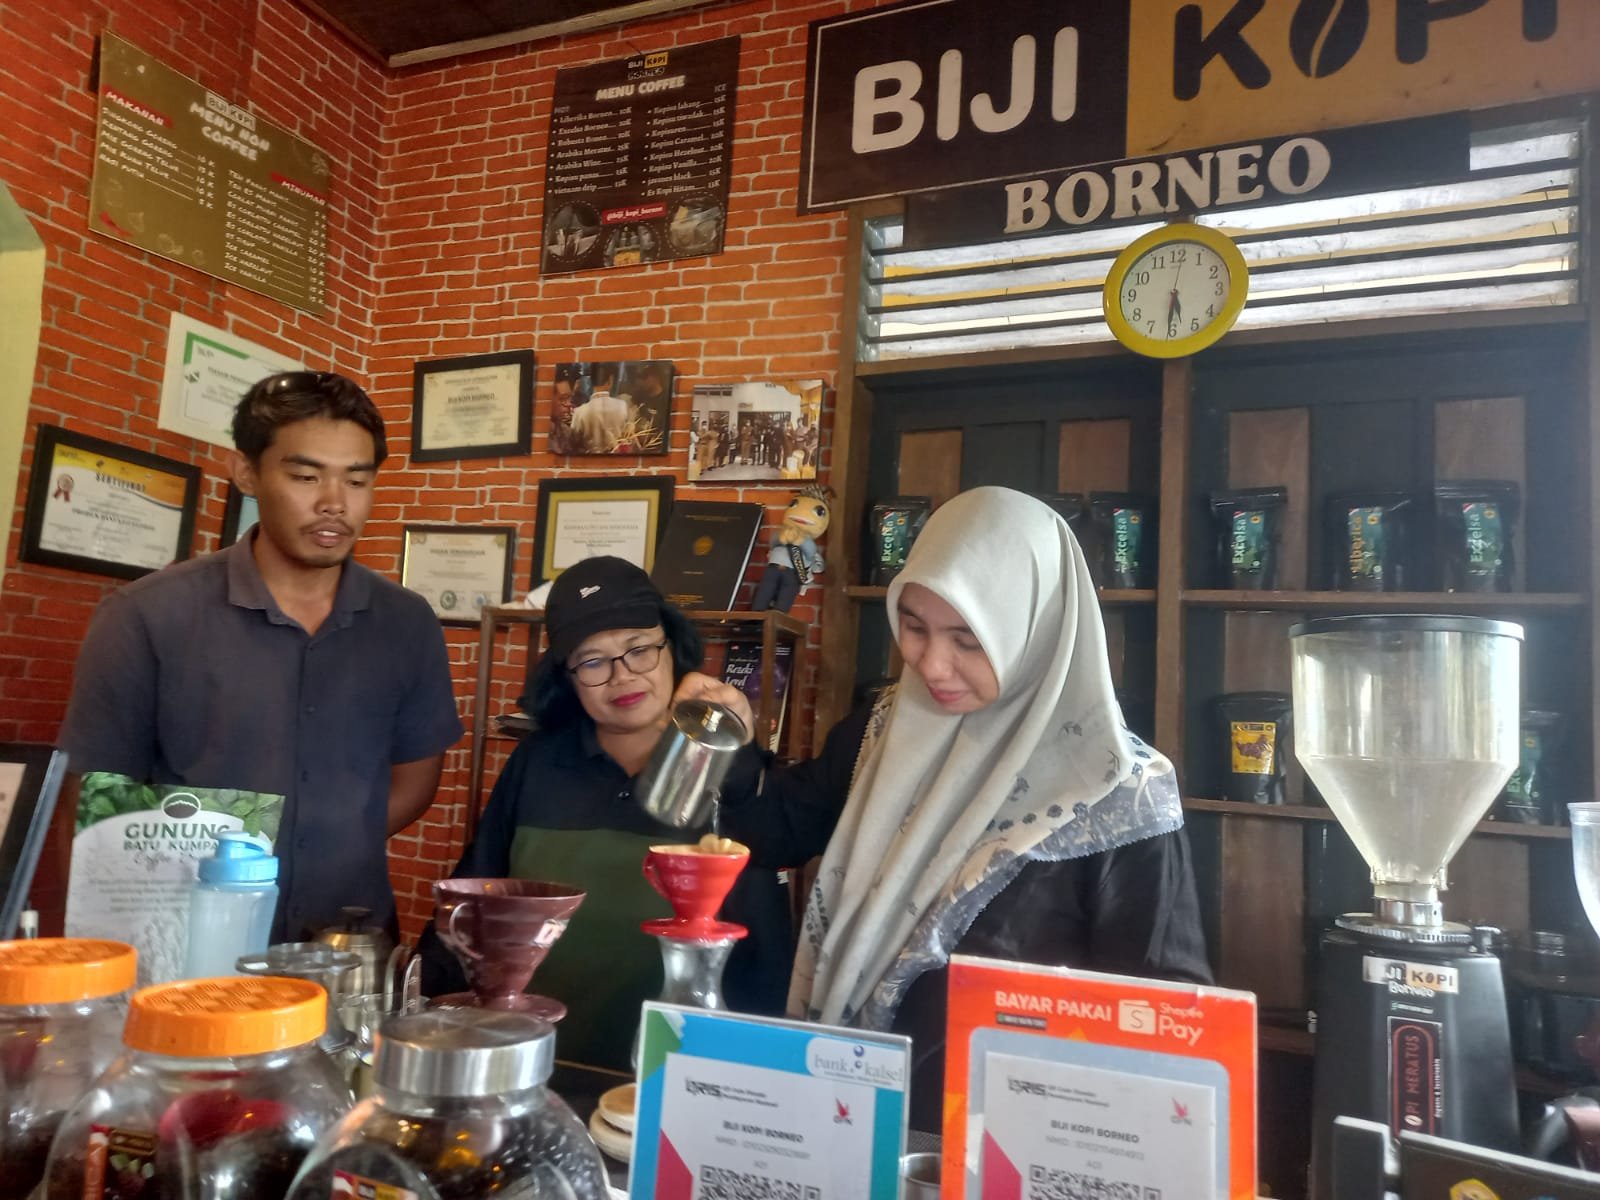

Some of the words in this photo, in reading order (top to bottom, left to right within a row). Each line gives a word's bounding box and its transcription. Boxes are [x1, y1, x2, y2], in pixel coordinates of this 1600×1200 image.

[595, 84, 634, 100] MENU
[638, 75, 685, 93] COFFEE
[852, 26, 1079, 154] BIJI
[105, 91, 163, 126] MAKANAN
[189, 102, 233, 133] MENU
[239, 127, 269, 152] NON
[201, 124, 256, 161] COFFEE
[281, 180, 324, 205] MINUMAN
[1003, 138, 1330, 233] BORNEO
[1152, 256, 1165, 269] 11
[1170, 249, 1186, 263] 12
[1196, 252, 1203, 266] 1
[1135, 271, 1150, 286] 10
[1209, 265, 1218, 280] 2
[1127, 289, 1137, 302] 9
[1214, 281, 1224, 296] 3
[1132, 308, 1142, 321] 8
[1205, 304, 1214, 318] 4
[1146, 320, 1156, 334] 7
[1168, 324, 1177, 337] 6
[1190, 318, 1200, 331] 5
[1114, 516, 1129, 563] Excelsa
[1232, 517, 1246, 564] Excelsa
[167, 840, 219, 851] KUMPA
[1412, 970, 1453, 987] KOPI
[995, 990, 1053, 1014] BAYAR
[1056, 998, 1112, 1022] PAKAI
[1158, 1014, 1204, 1047] Pay
[815, 1054, 848, 1072] bank
[1405, 1035, 1421, 1095] MERATUS
[742, 1124, 762, 1135] KOPI
[766, 1128, 804, 1143] BORNEO
[1050, 1120, 1069, 1131] BIJI
[1070, 1124, 1095, 1136] KOPI
[1097, 1128, 1140, 1144] BORNEO
